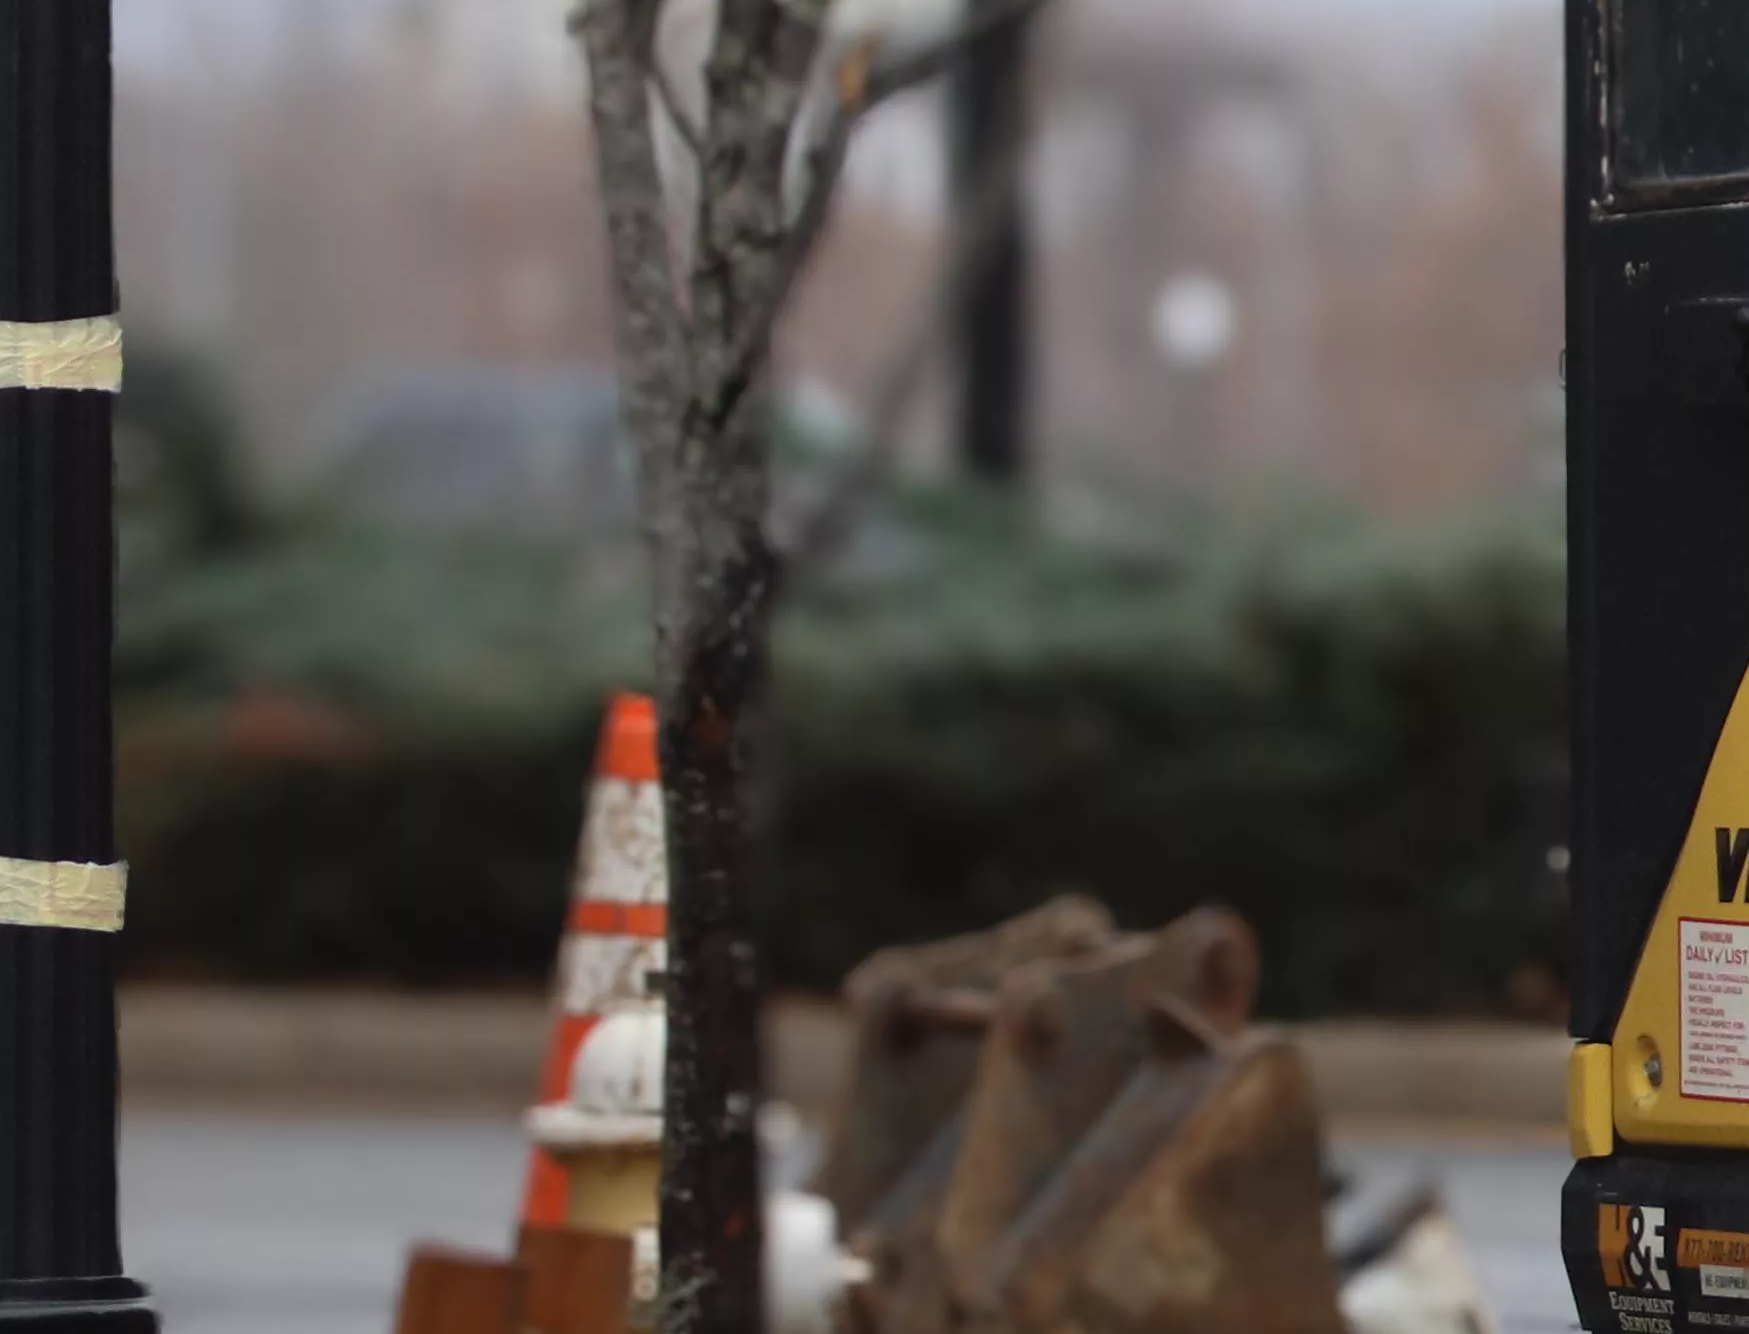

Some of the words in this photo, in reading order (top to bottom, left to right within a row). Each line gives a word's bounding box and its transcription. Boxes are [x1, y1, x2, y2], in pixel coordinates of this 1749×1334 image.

[1686, 945, 1713, 963] DAILY
[1725, 948, 1748, 964] LIST
[1609, 1291, 1674, 1315] EQUIPMENT
[1619, 1312, 1673, 1334] SERVICES
